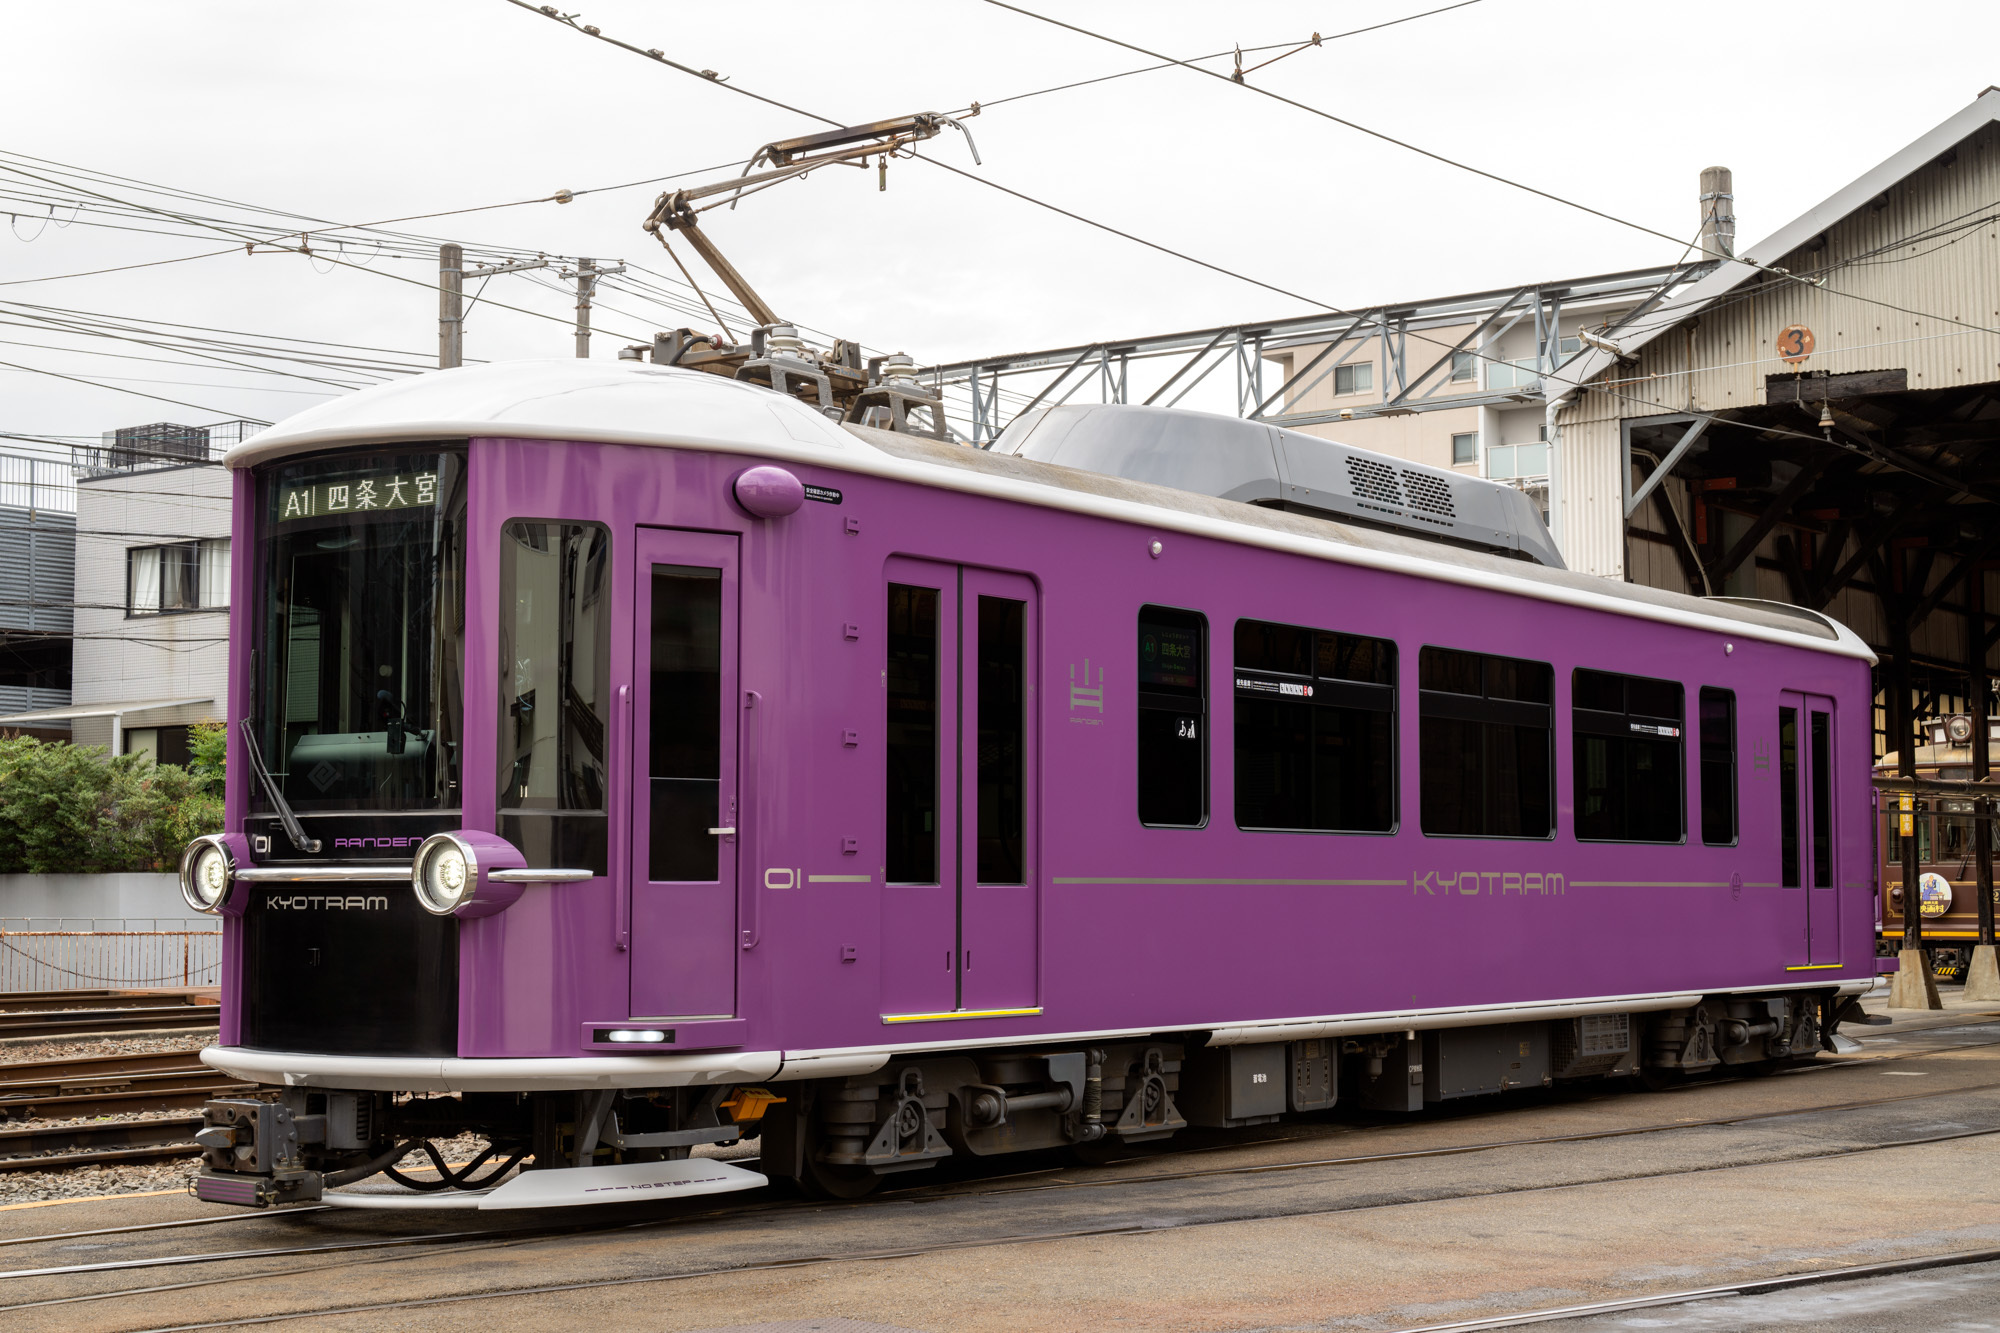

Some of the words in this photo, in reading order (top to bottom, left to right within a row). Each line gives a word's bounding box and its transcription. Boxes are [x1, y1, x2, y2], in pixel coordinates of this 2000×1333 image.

[1785, 329, 1804, 356] 3
[328, 472, 437, 510] 四条大宮
[1413, 870, 1565, 895] KYOTRAM
[266, 896, 388, 910] KYOTRAM
[653, 1179, 692, 1188] STEP
